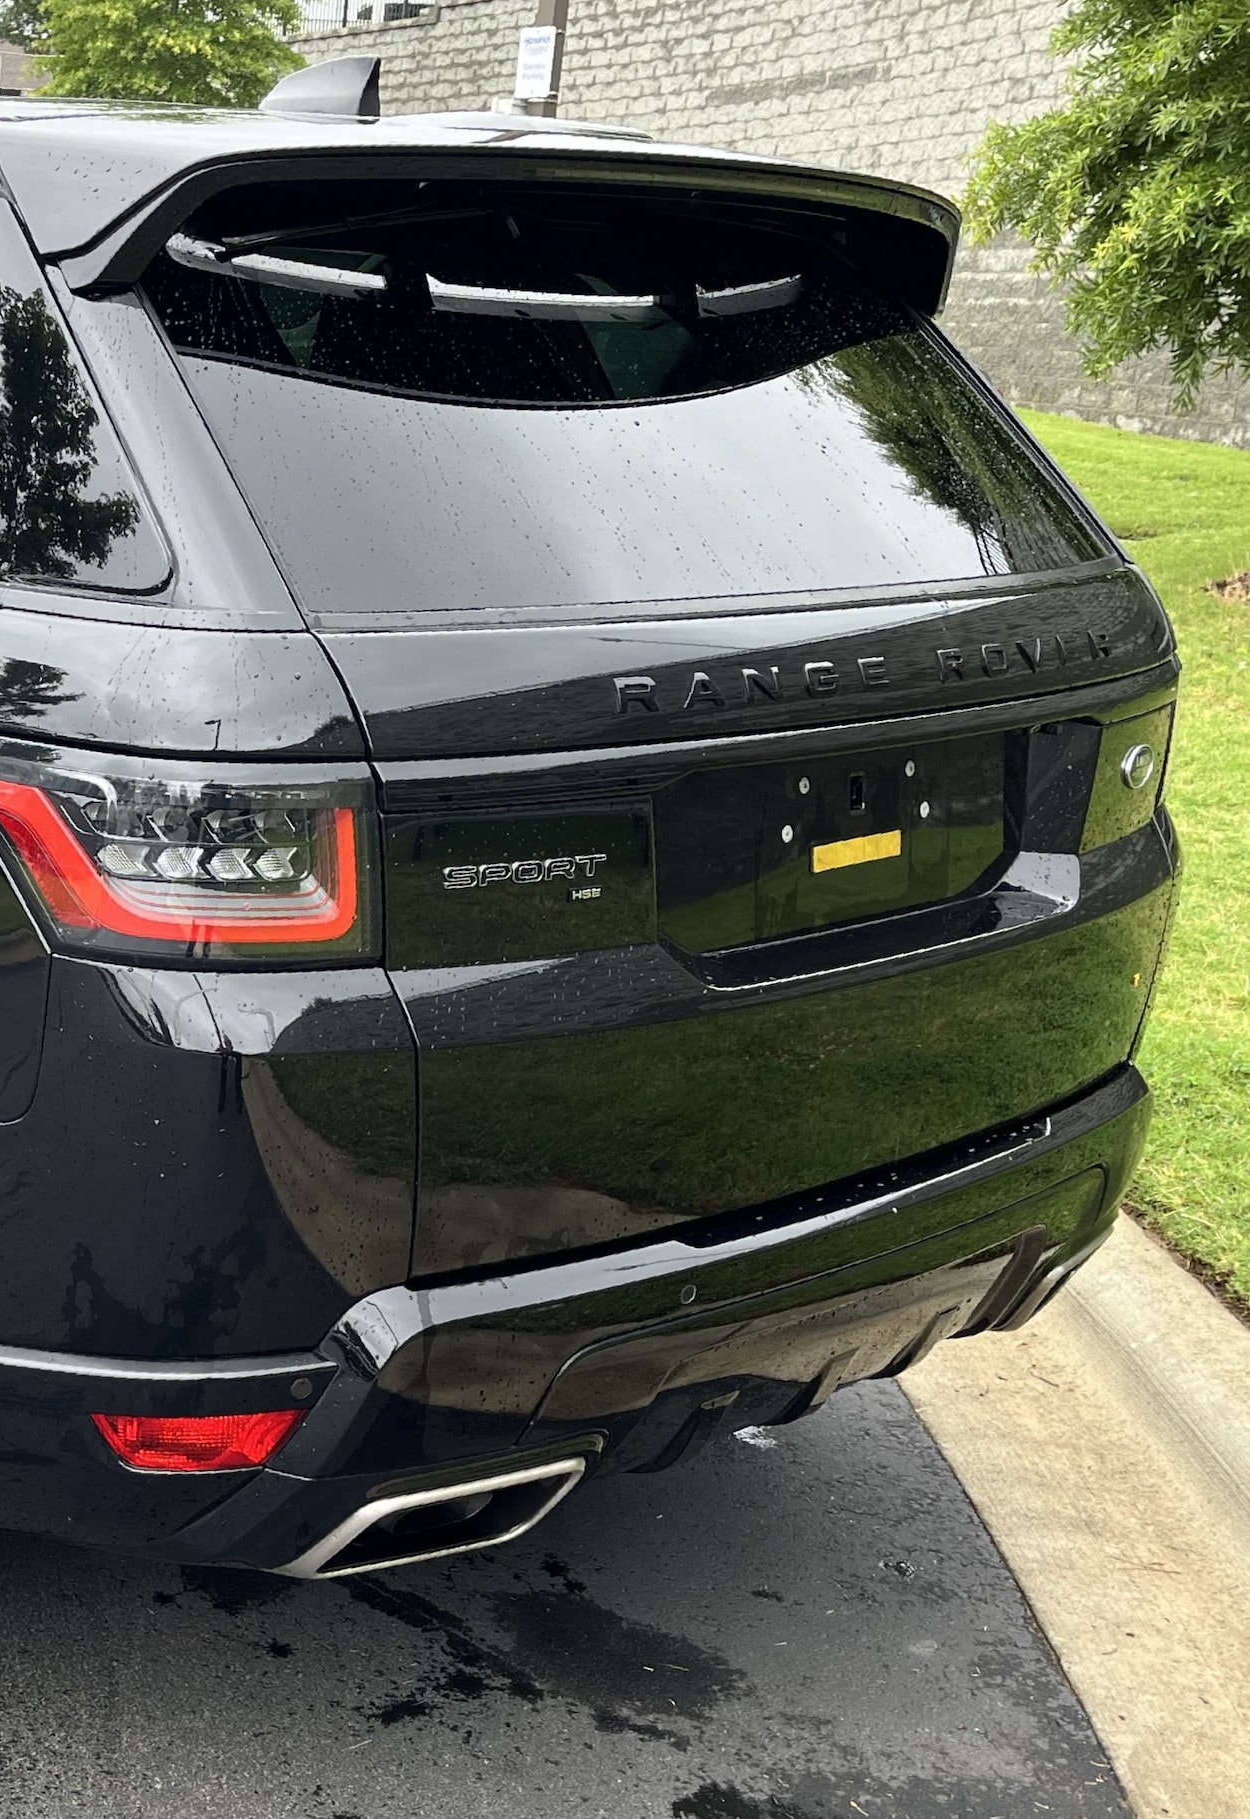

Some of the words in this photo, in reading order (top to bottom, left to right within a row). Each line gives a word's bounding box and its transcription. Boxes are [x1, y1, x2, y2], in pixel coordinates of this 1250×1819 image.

[612, 656, 890, 714] RANGE
[442, 853, 607, 889] SPORT
[571, 887, 602, 901] HSE
